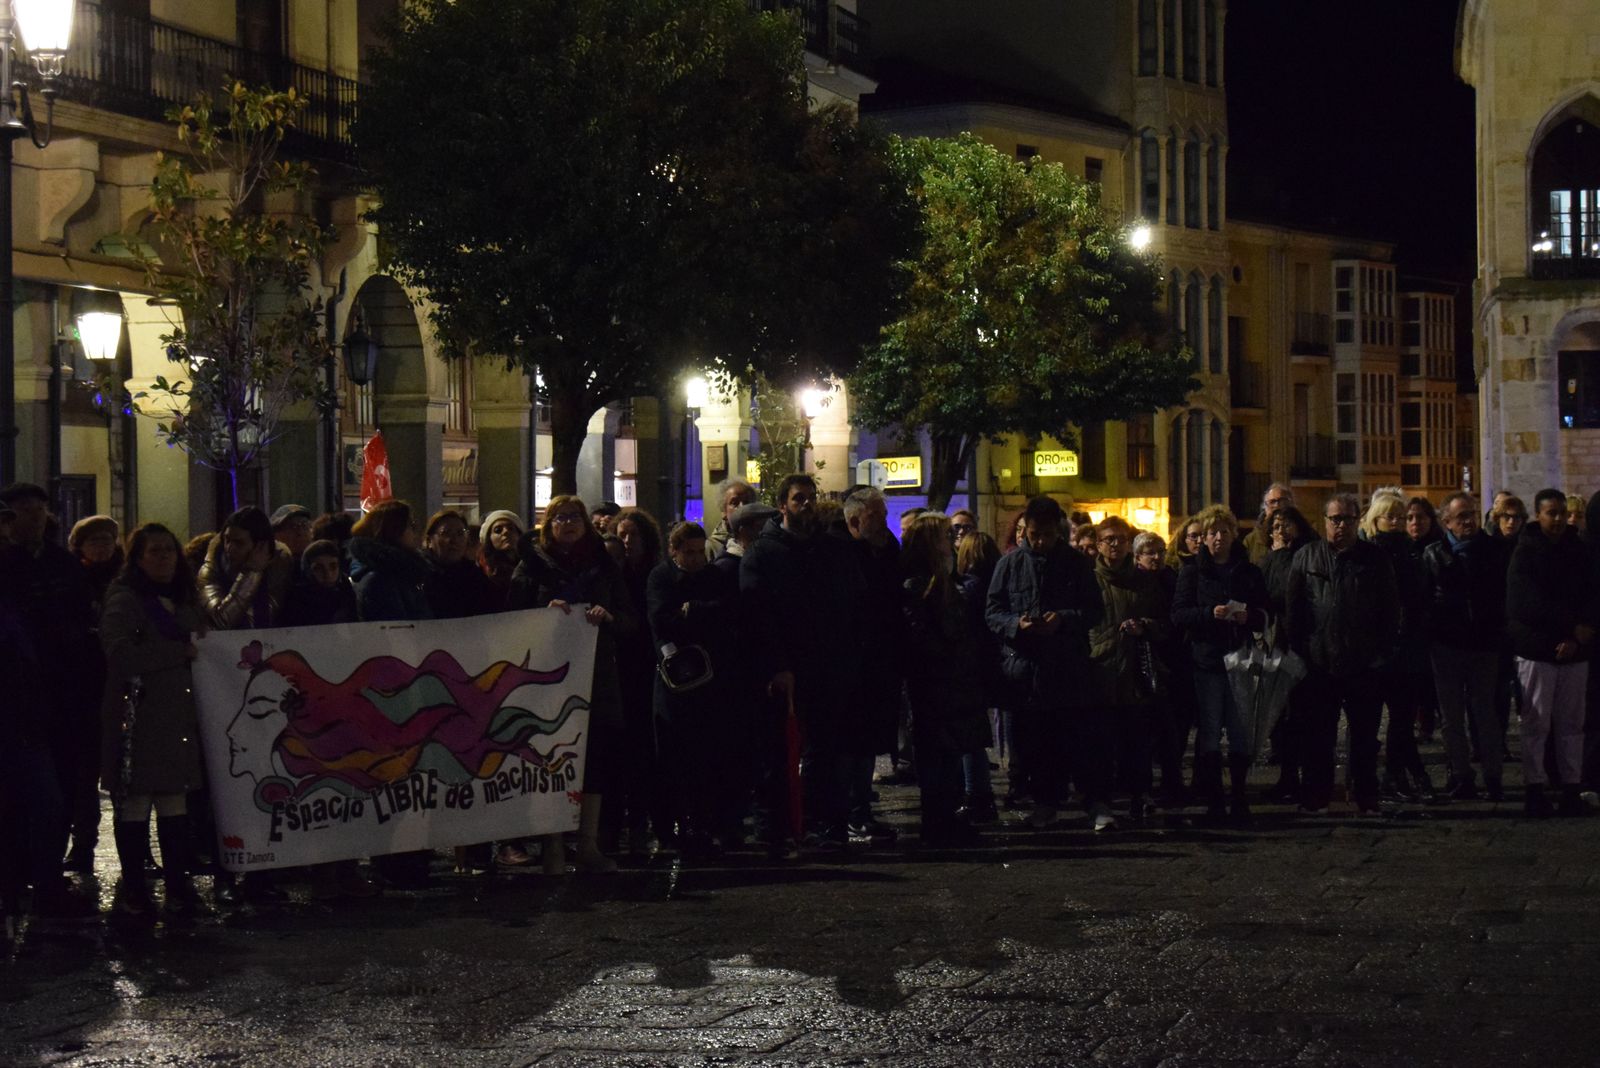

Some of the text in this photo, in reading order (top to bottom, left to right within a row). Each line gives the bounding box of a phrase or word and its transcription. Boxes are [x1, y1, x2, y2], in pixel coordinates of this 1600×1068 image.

[1036, 454, 1060, 465] ORO
[269, 760, 576, 842] Espacio LIBRE de machismo
